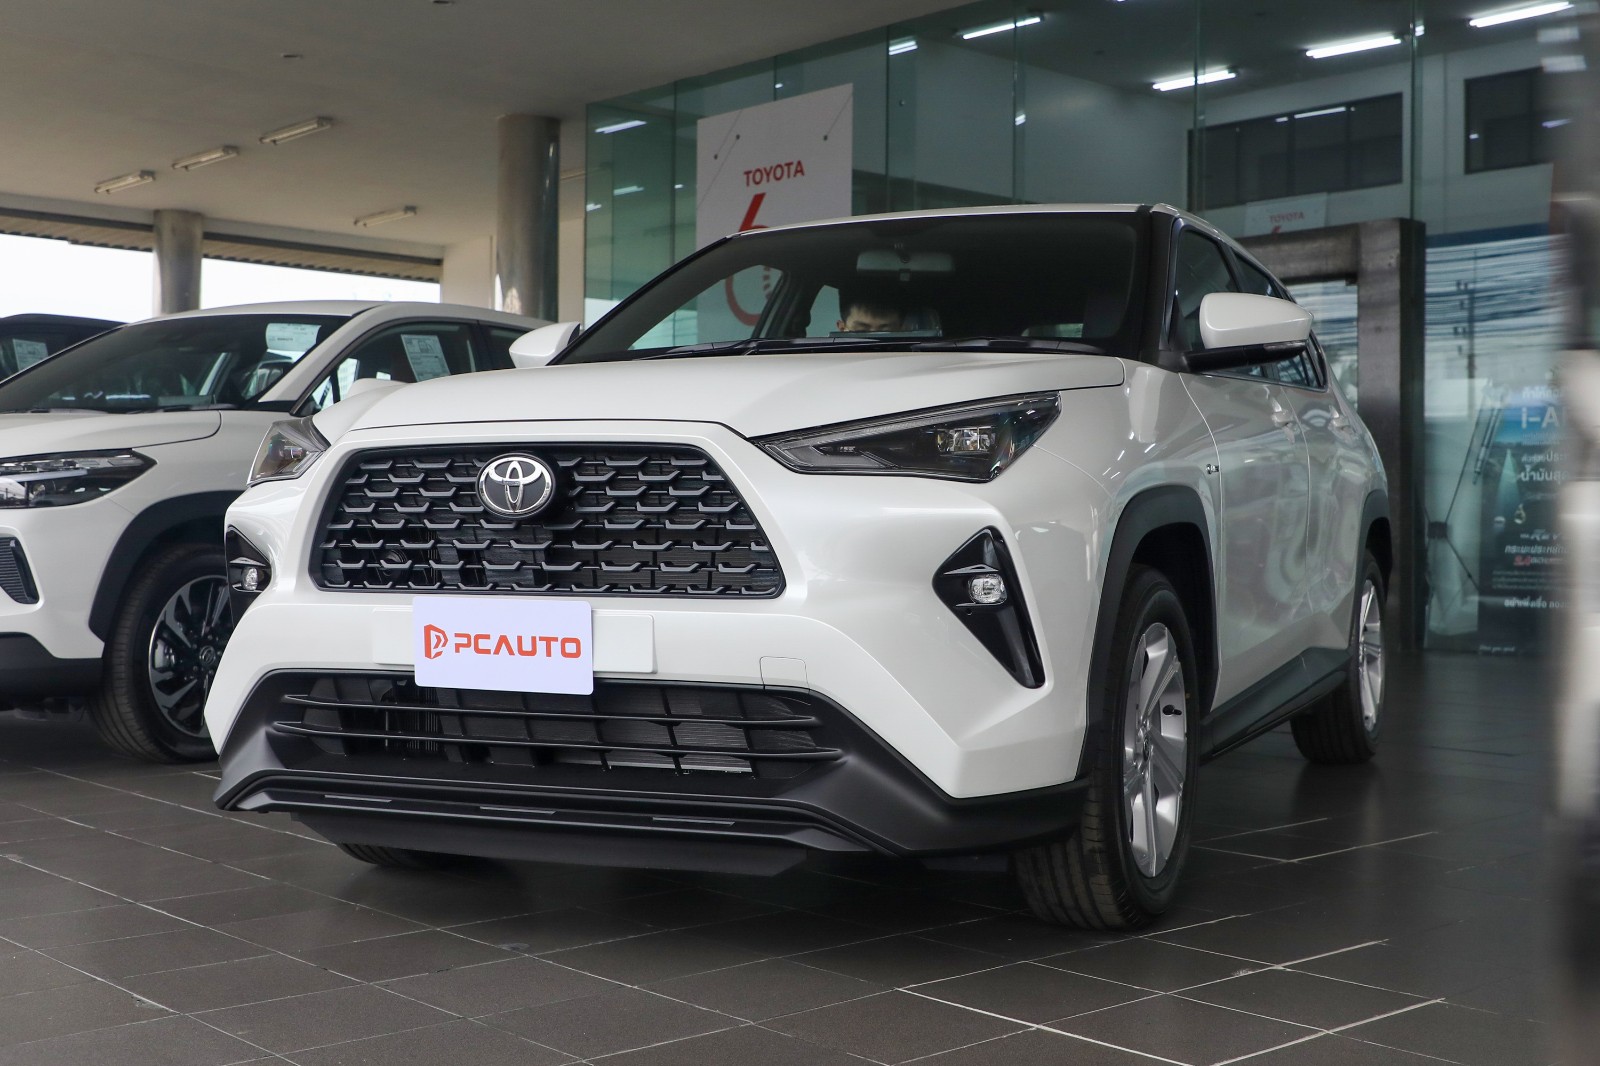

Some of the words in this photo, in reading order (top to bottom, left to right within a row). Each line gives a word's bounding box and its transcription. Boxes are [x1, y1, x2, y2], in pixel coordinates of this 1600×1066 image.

[743, 160, 805, 187] TOYOTA
[1269, 211, 1304, 223] TOYOTA
[454, 632, 582, 659] PCAUTO
